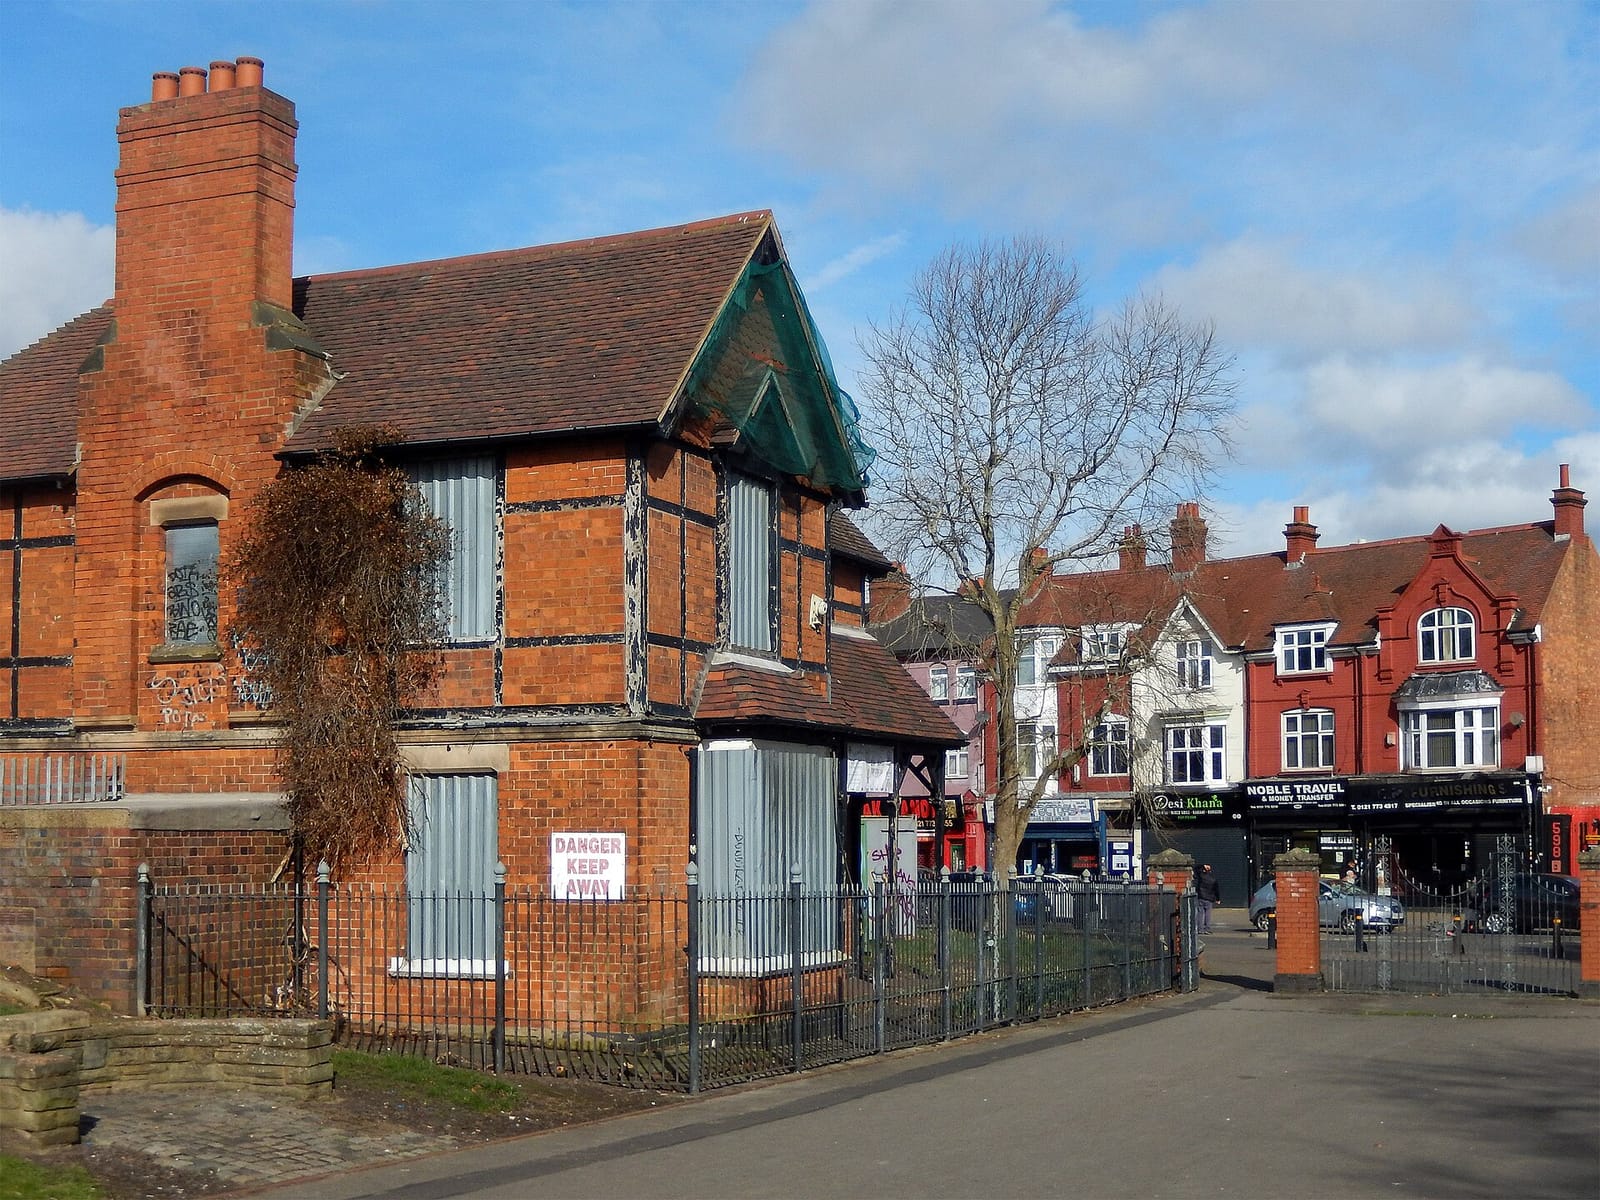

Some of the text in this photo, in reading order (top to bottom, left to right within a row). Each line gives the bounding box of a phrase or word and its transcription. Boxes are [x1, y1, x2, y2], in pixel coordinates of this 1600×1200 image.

[1247, 783, 1345, 795] NOBLE TRAVEL
[1187, 795, 1223, 808] Khana
[555, 837, 622, 854] DANGER
[567, 858, 610, 875] KEEP
[566, 878, 611, 896] AWAY
